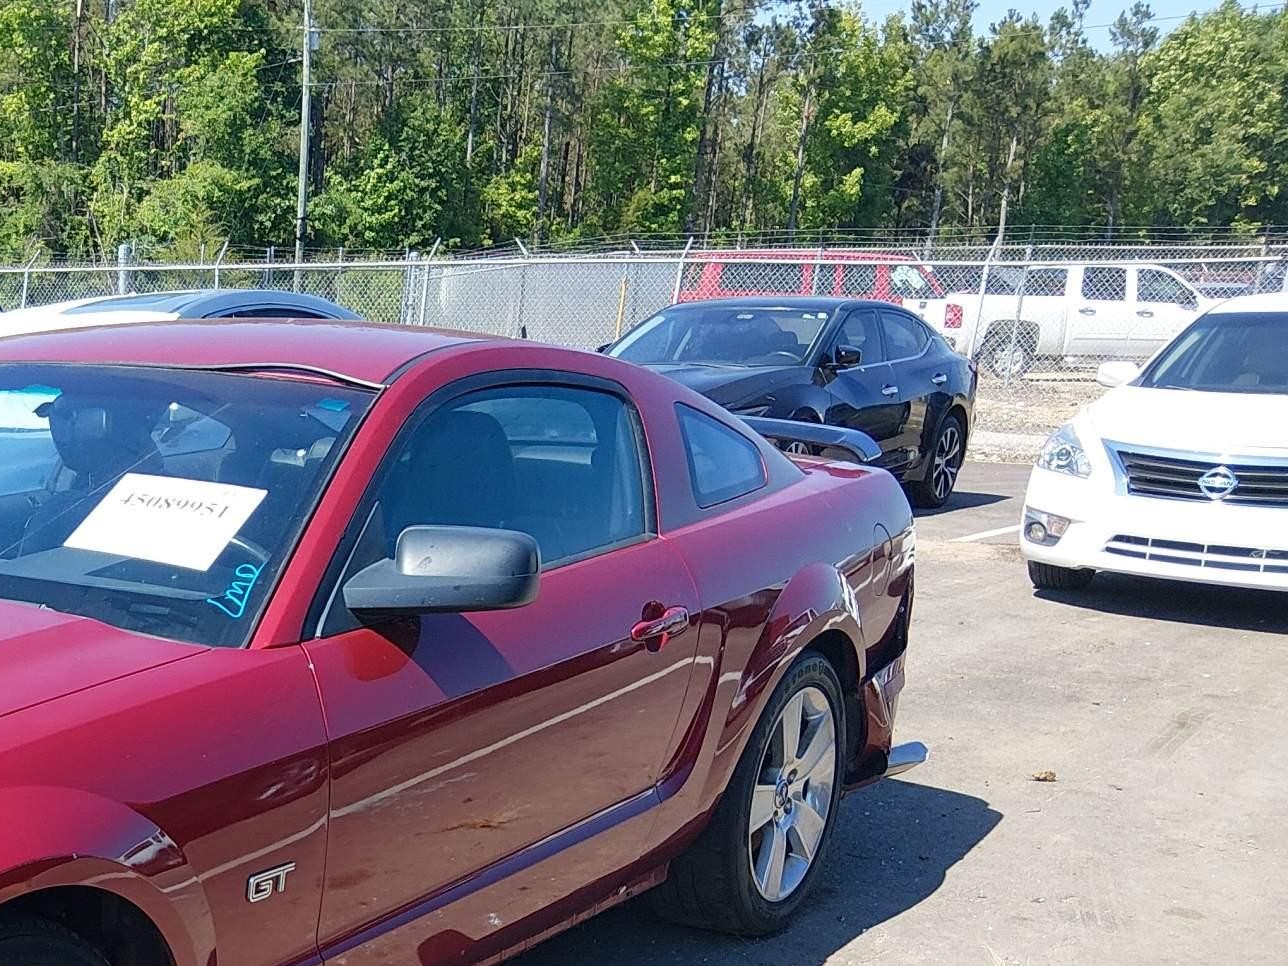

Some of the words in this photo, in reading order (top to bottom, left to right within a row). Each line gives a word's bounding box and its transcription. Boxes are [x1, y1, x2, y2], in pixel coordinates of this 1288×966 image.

[1201, 479, 1234, 487] NISAN
[119, 492, 230, 518] 45089951
[247, 862, 296, 903] GT
